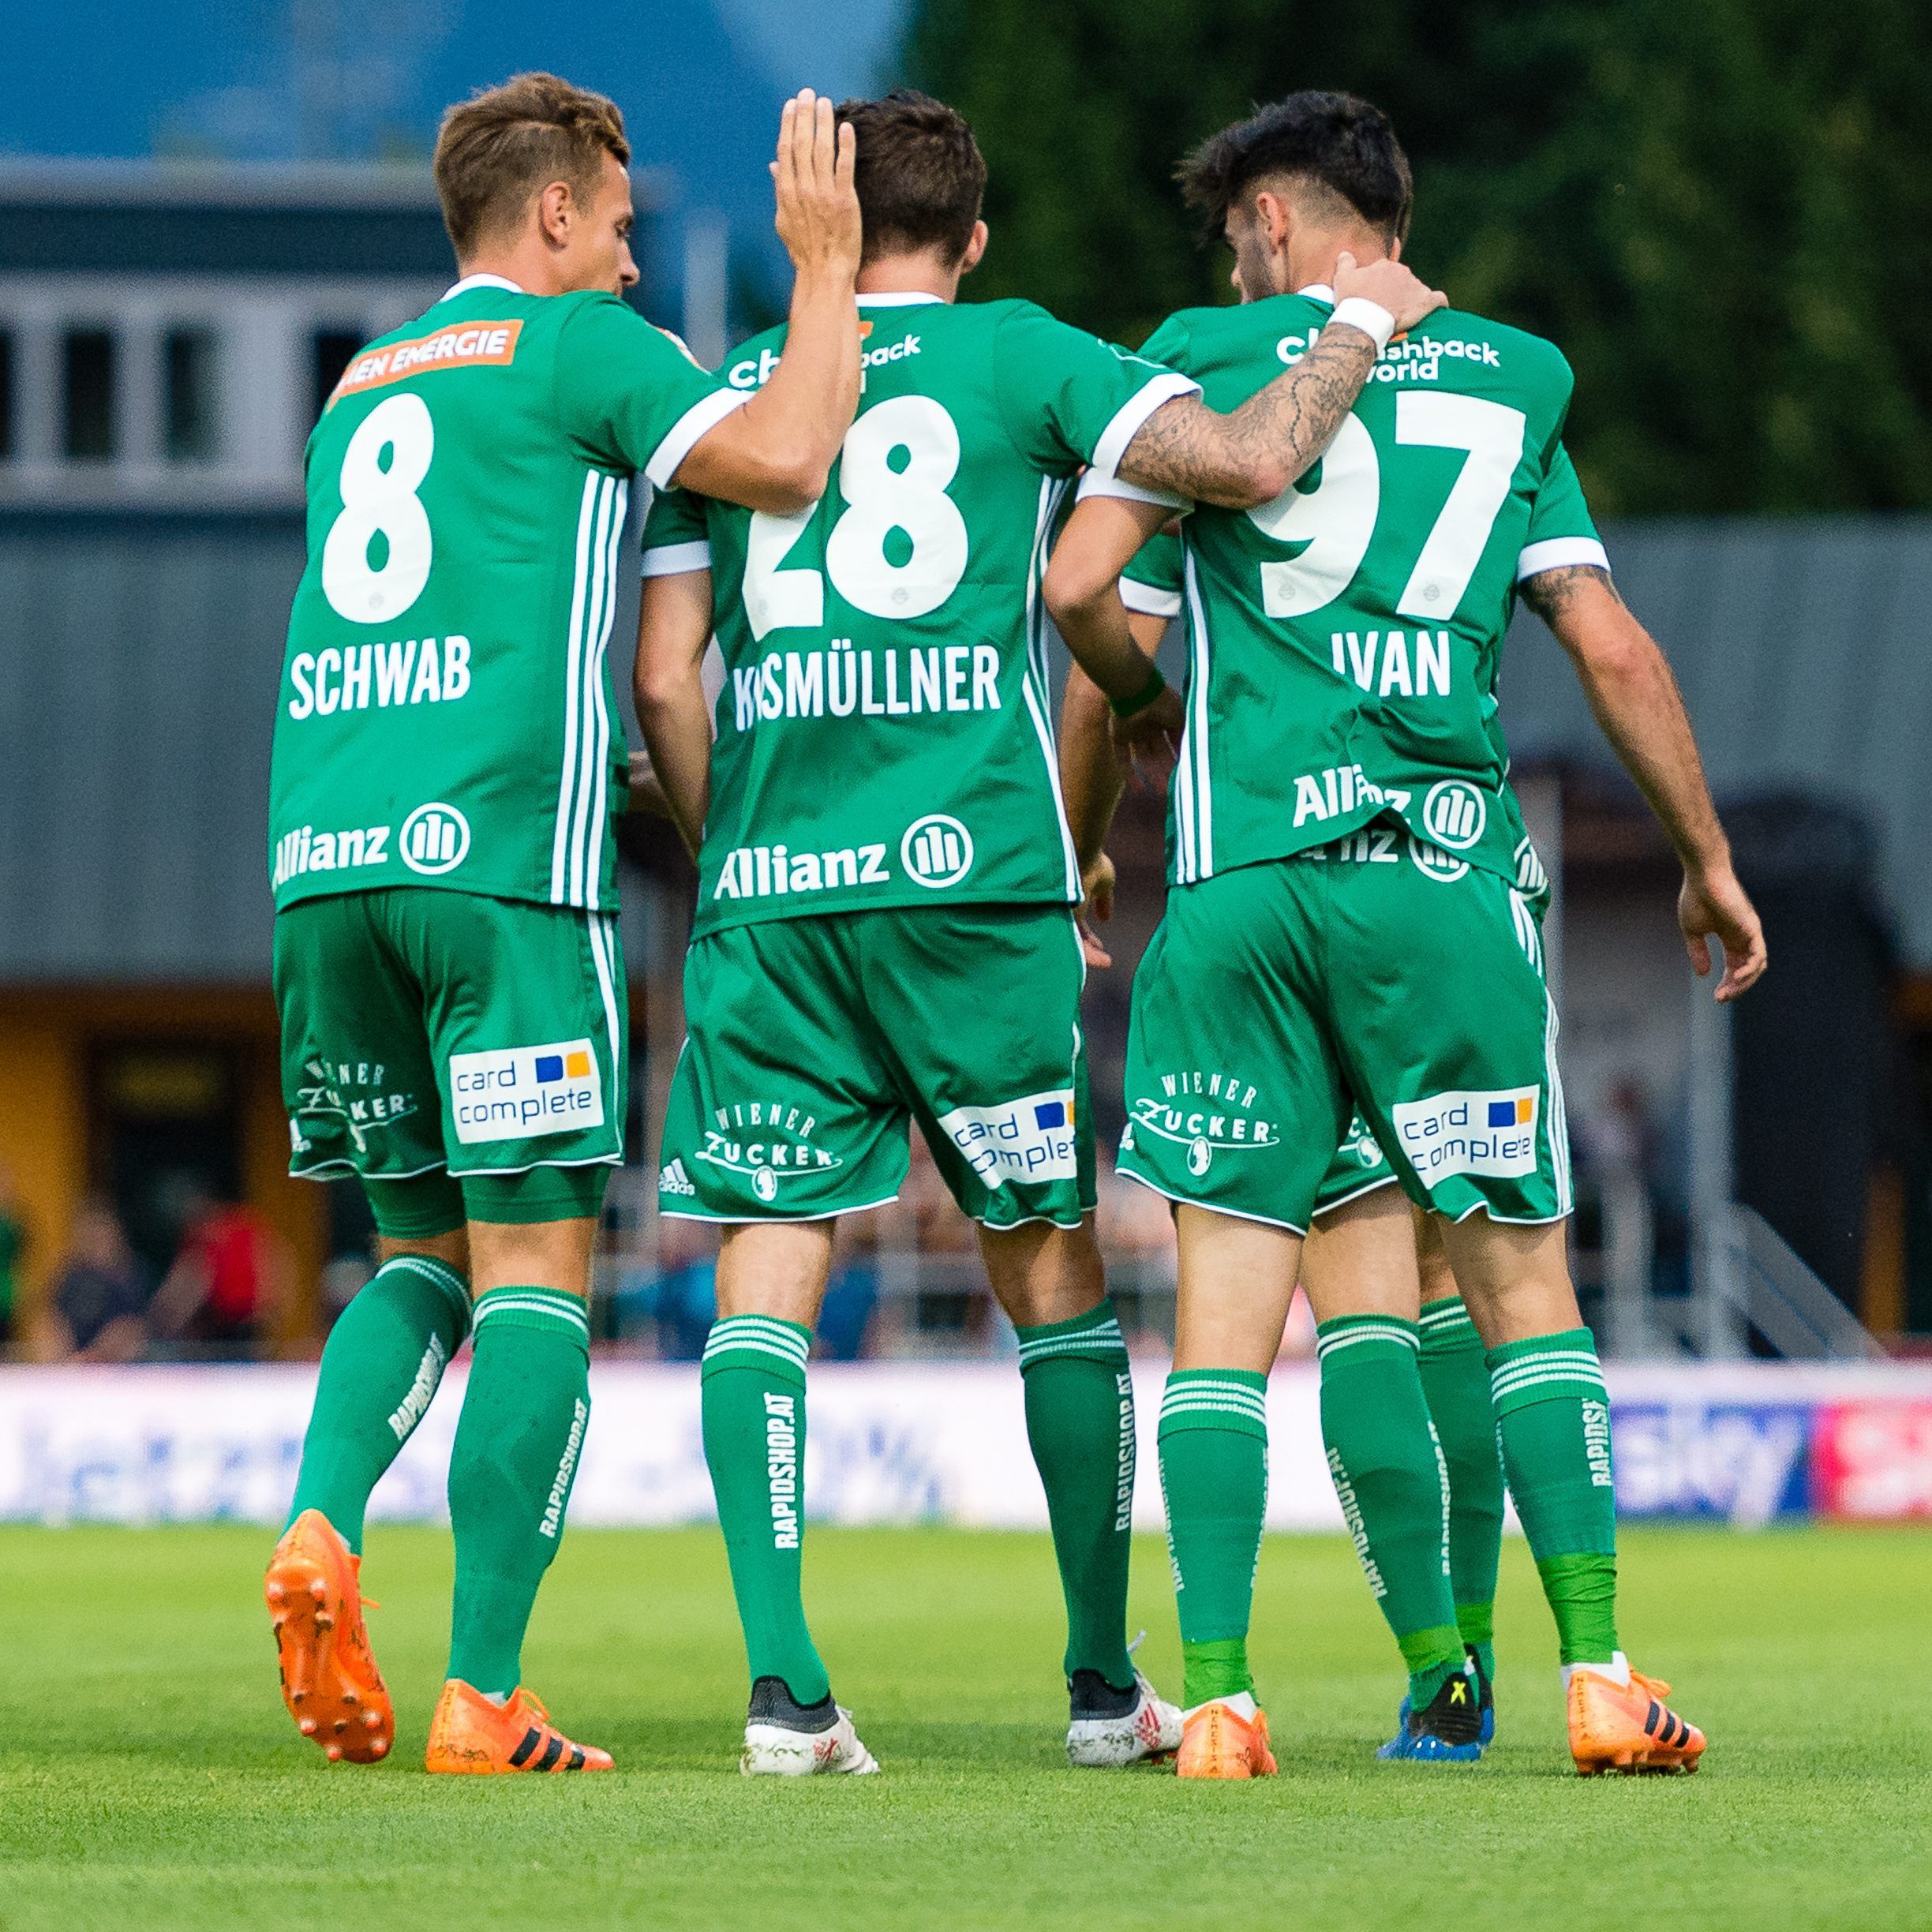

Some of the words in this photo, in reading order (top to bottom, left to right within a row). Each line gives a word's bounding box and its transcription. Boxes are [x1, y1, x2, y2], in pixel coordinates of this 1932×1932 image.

[331, 353, 390, 395] IEN
[389, 328, 510, 373] ENERGIE
[1376, 335, 1501, 368] shback
[322, 393, 435, 624] 8
[1245, 389, 1527, 621] 97
[289, 635, 471, 720] SCHWAB
[733, 638, 1002, 732] KSMÜLLNER
[1331, 631, 1451, 696] IVAN
[713, 842, 890, 900] Allianz
[457, 1060, 516, 1092] card
[1161, 1071, 1257, 1109] WIENER
[459, 1088, 592, 1126] complete
[715, 1103, 816, 1138] WIENER
[954, 1113, 1019, 1148] card
[1135, 1097, 1271, 1143] ZUCKER
[1403, 1102, 1468, 1140] card
[763, 1392, 799, 1549] RAPIDSHOP.AT
